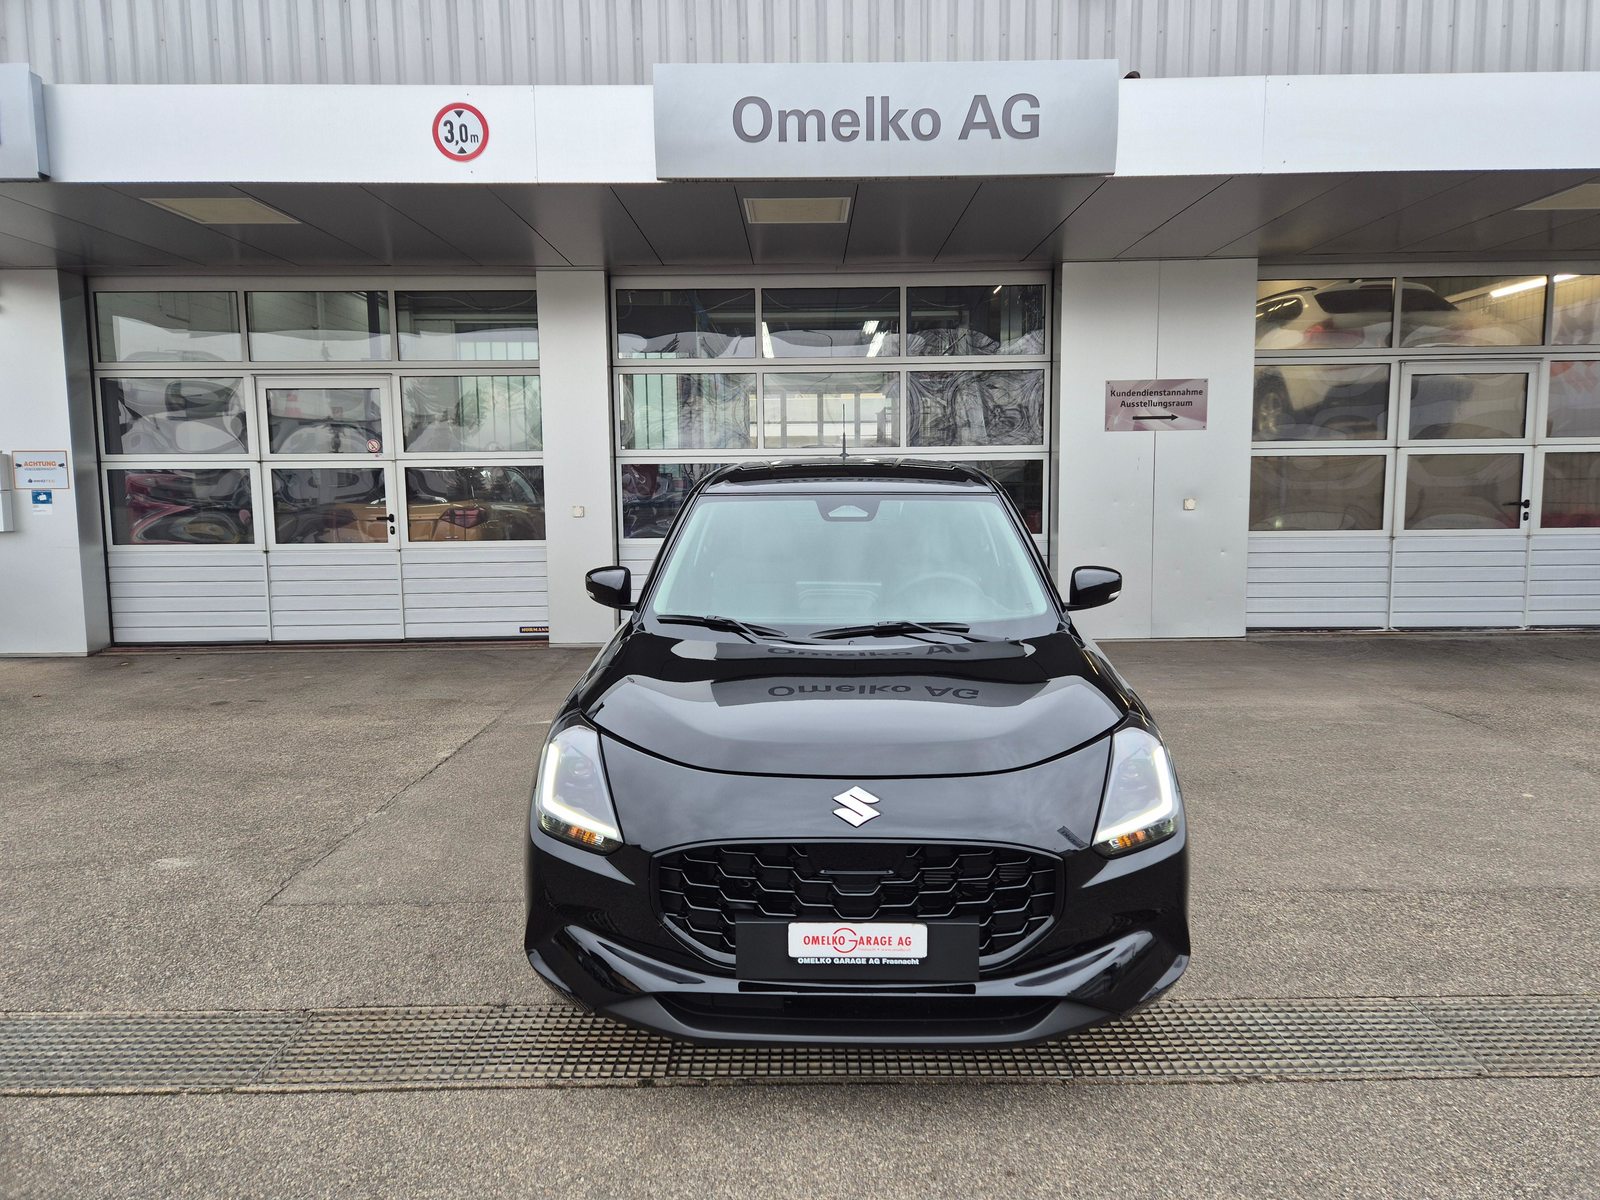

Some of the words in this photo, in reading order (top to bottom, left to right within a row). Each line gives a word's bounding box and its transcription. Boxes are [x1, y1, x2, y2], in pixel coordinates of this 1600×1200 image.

[732, 95, 941, 143] Omelko
[957, 93, 1041, 140] AG
[1110, 388, 1204, 398] Kundendienstannahme
[1120, 400, 1193, 409] Ausstellungsraum
[803, 935, 846, 946] OMELKO
[897, 936, 912, 946] AG
[797, 957, 832, 965] OMELKO
[833, 957, 867, 965] GARAGE
[868, 957, 881, 965] AG
[881, 957, 920, 965] Frasnacht
